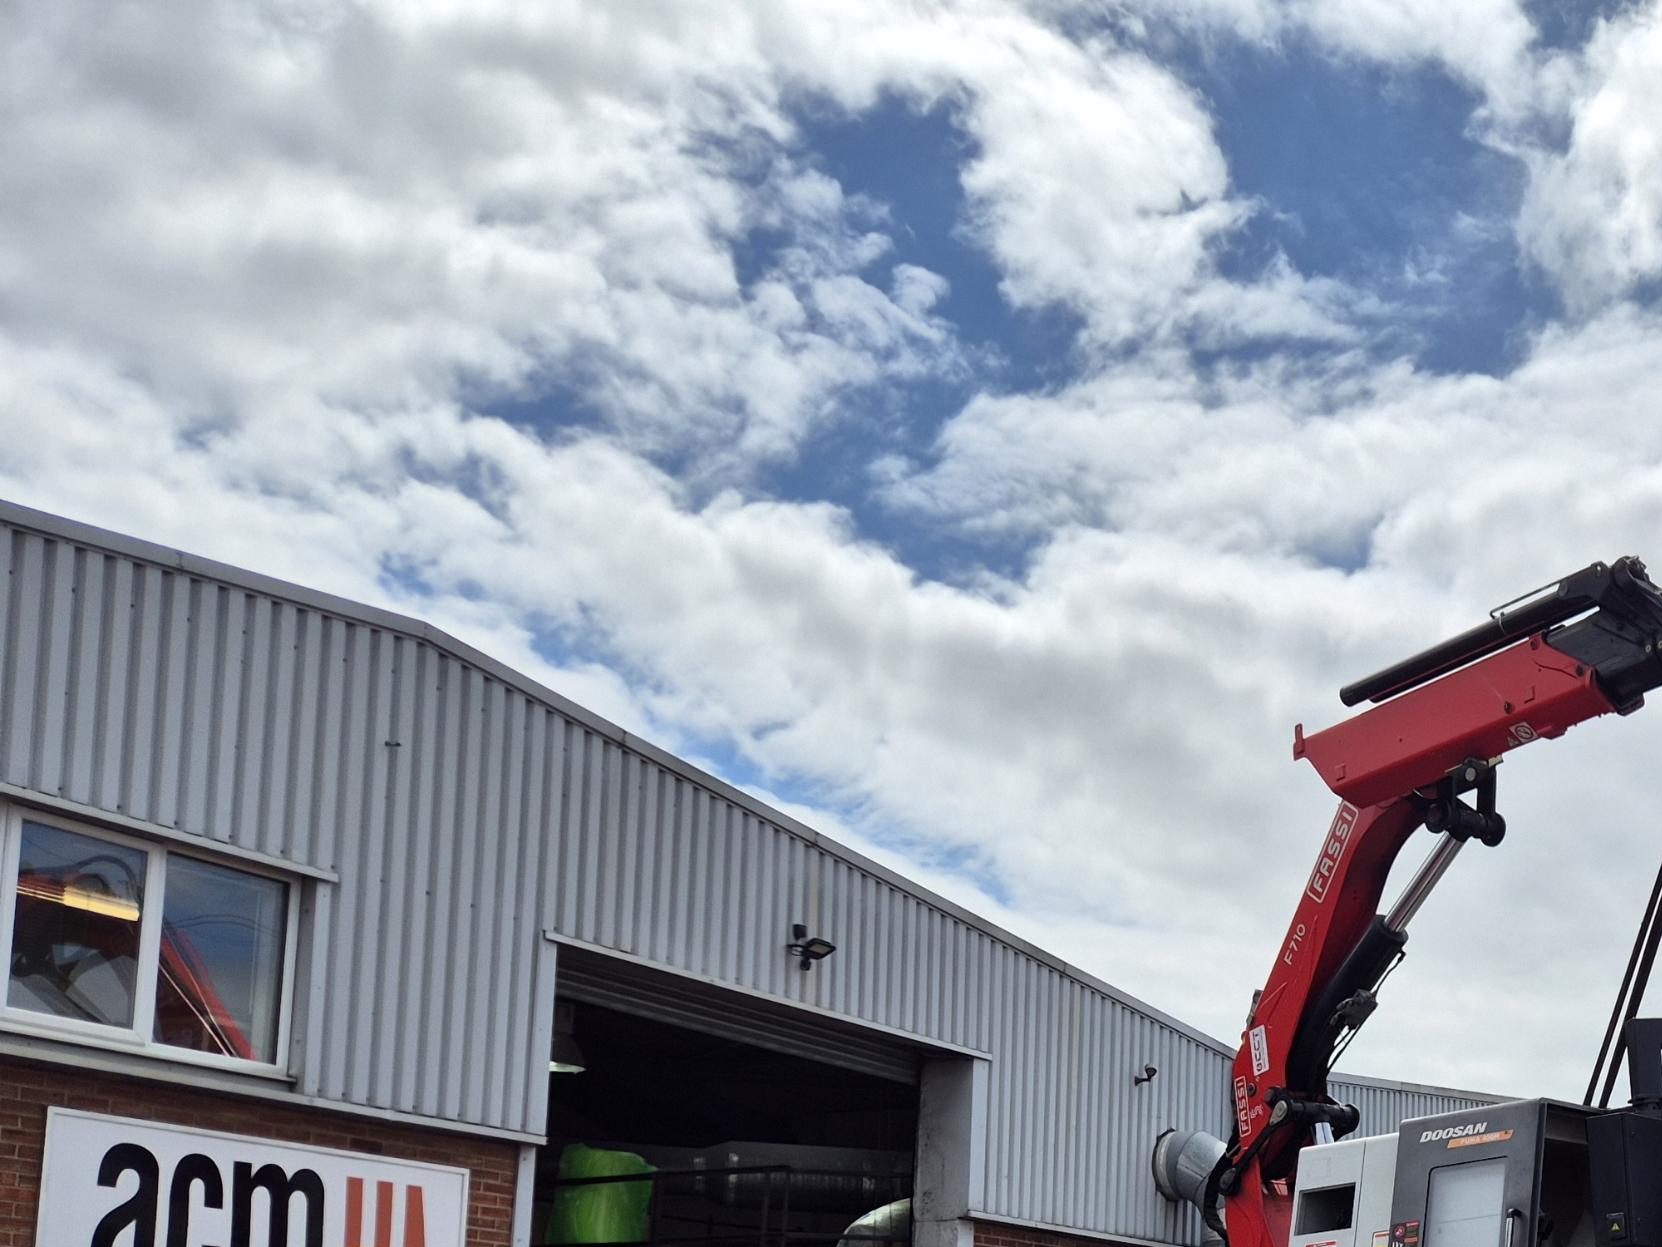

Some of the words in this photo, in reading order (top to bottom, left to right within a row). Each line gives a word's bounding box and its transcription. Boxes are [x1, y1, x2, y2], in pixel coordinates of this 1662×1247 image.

[1313, 811, 1353, 893] FASSI
[1284, 923, 1306, 966] F710
[1237, 1080, 1249, 1132] FASSI
[1420, 1122, 1488, 1143] DOOSAN
